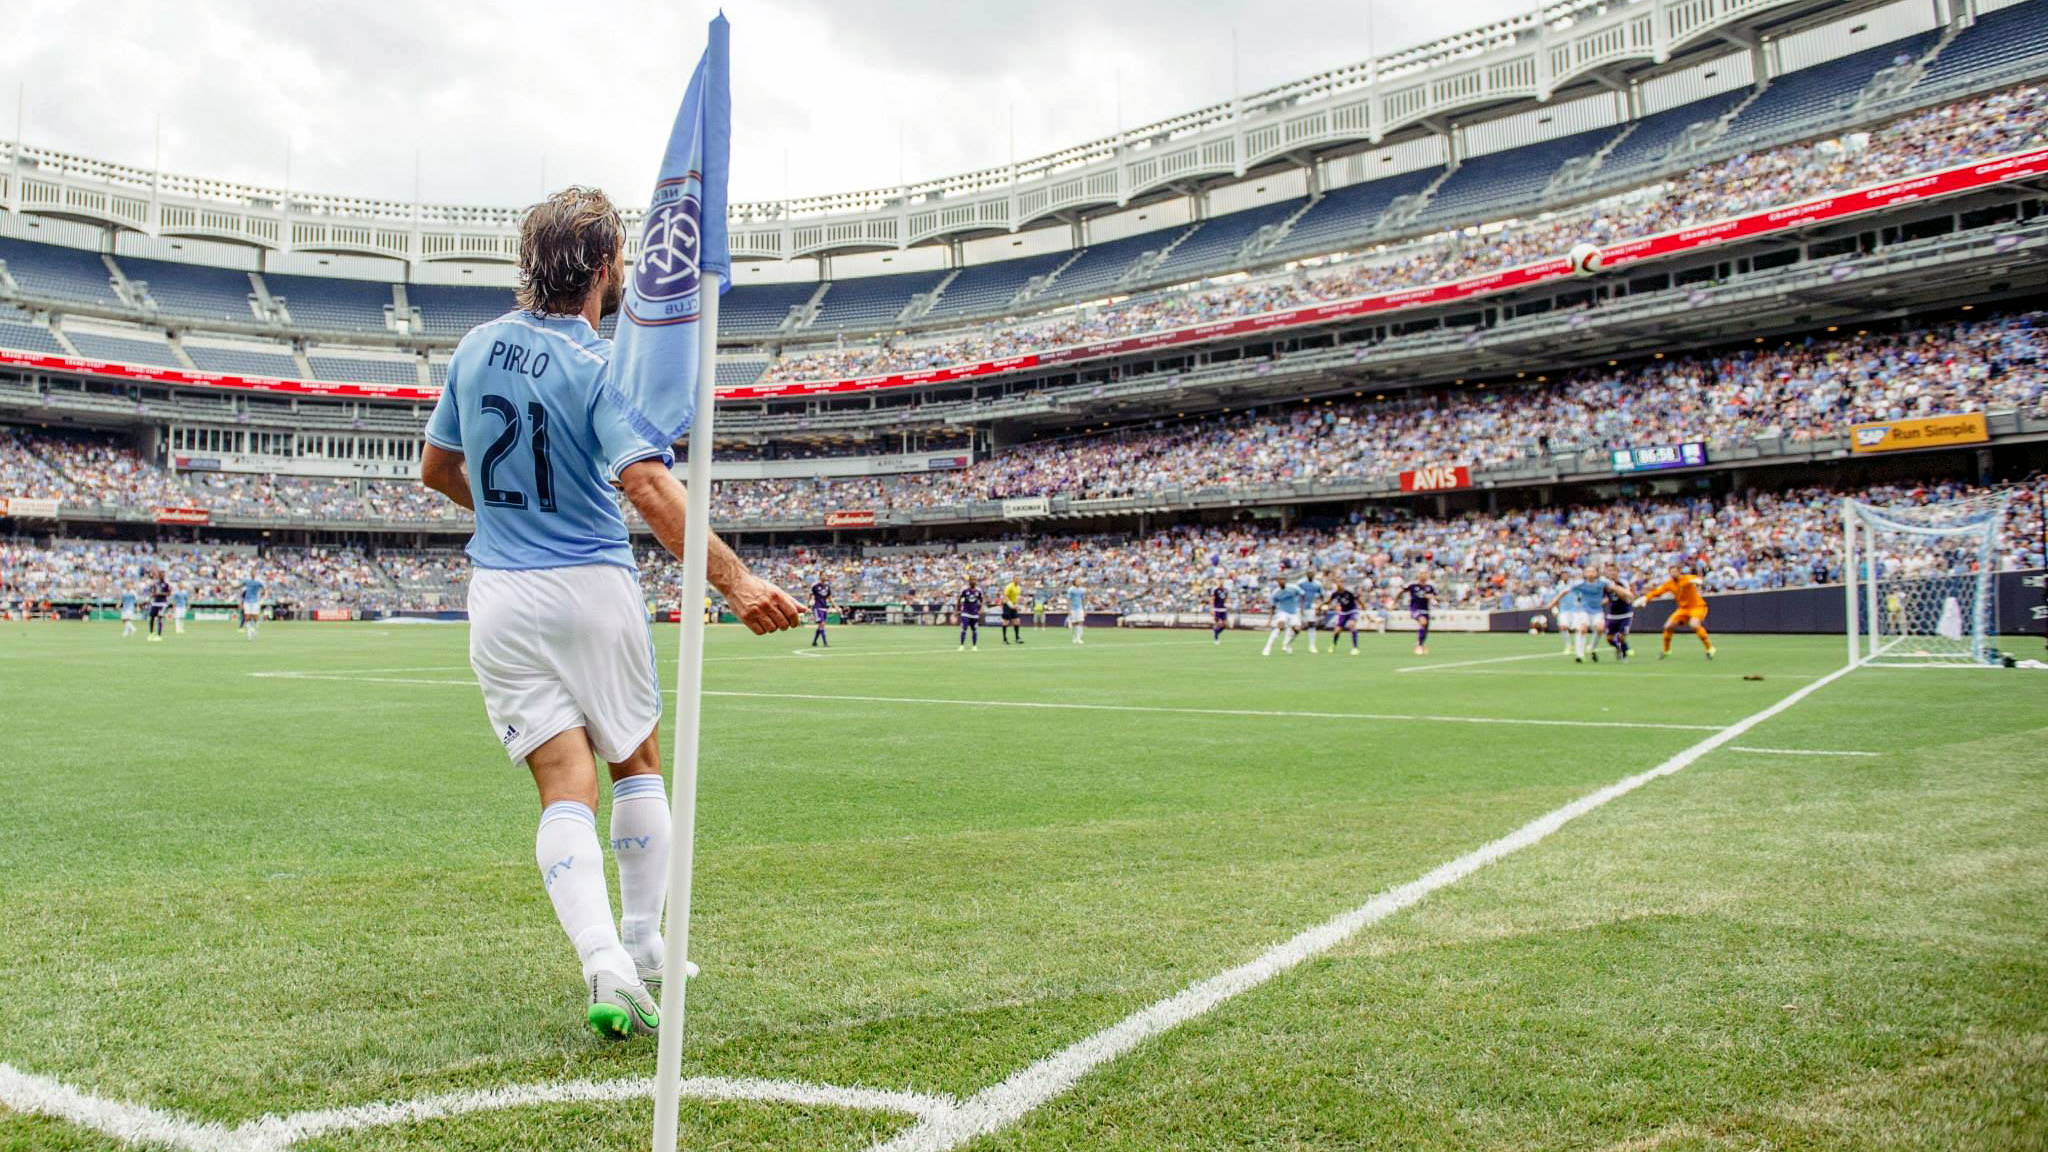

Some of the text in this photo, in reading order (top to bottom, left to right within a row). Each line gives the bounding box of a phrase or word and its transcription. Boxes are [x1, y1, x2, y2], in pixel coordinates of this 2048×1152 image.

[1976, 160, 2014, 175] GRAND
[488, 340, 550, 379] PIRLO
[1856, 422, 1977, 446] SAP Run Simple
[480, 394, 558, 513] 21
[1413, 466, 1457, 491] AVIS
